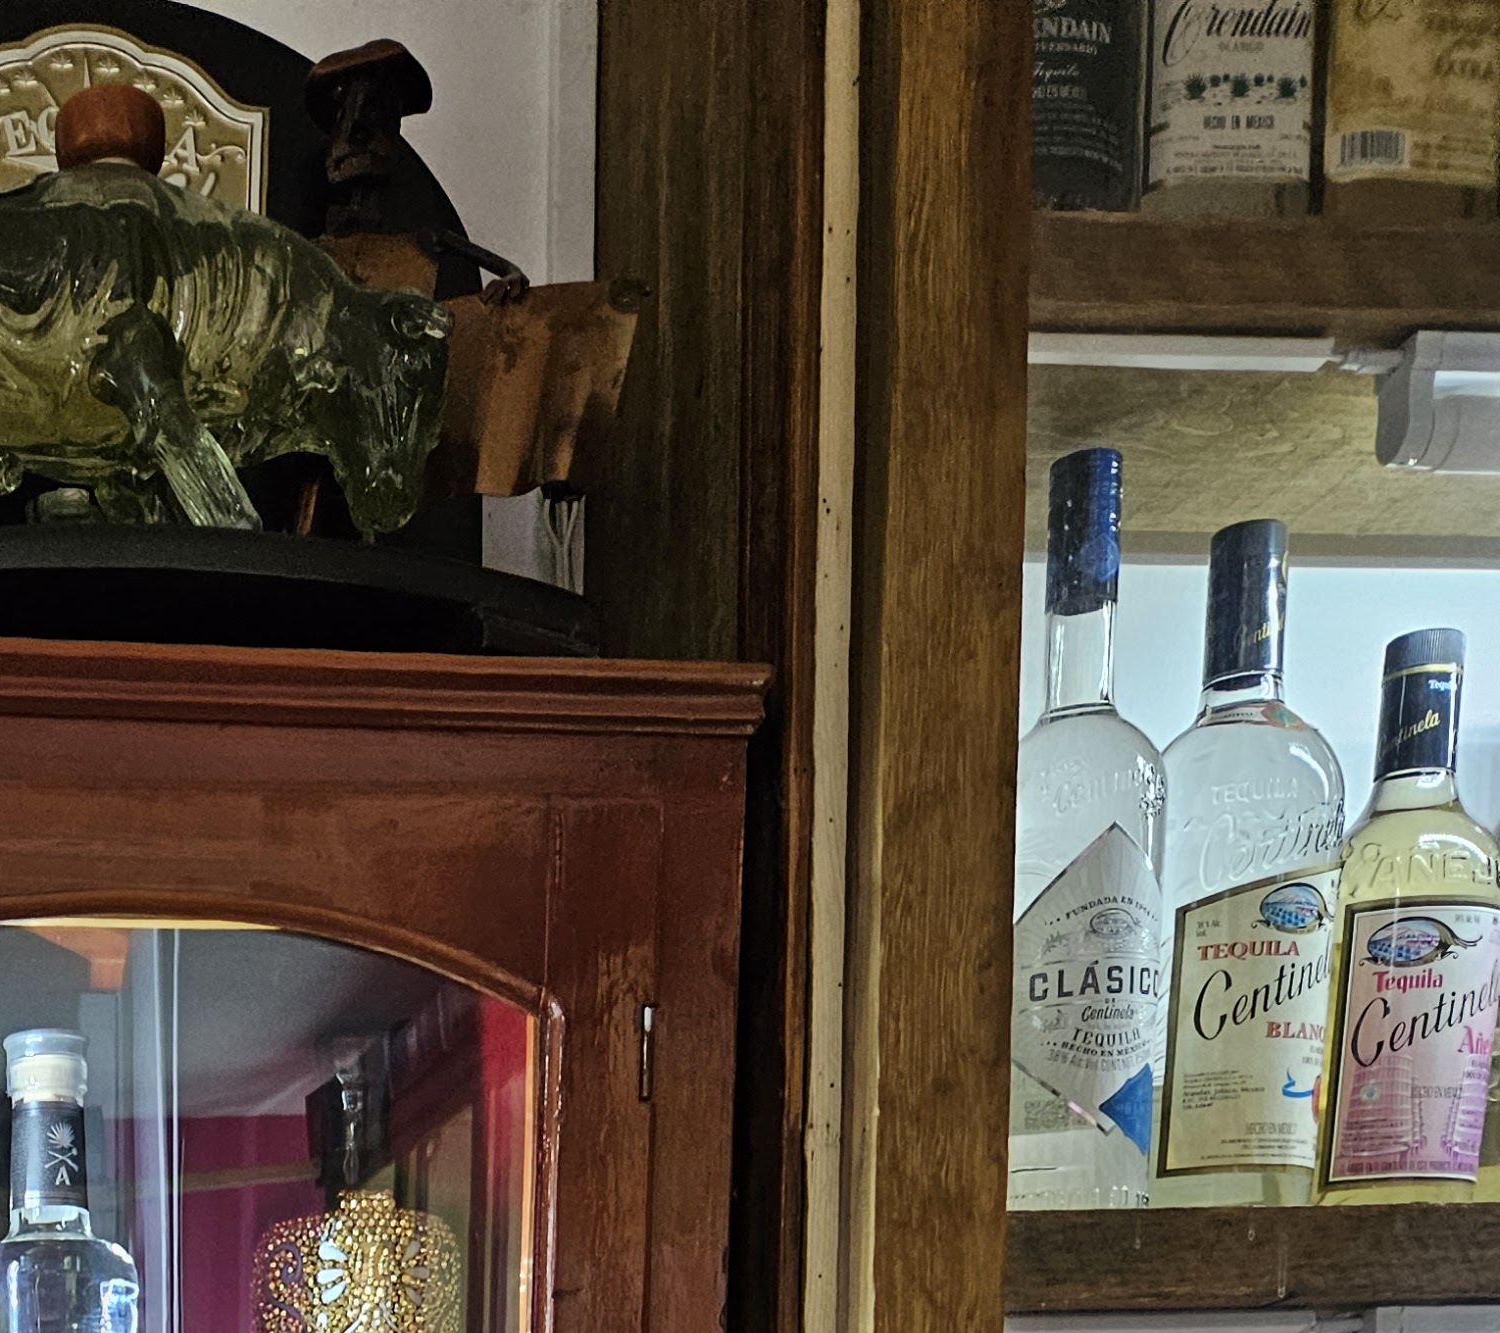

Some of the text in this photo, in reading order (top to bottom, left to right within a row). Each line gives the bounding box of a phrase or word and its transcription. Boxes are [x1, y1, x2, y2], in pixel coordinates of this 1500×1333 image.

[1197, 940, 1300, 961] TEQUILA
[1193, 930, 1331, 1041] Centinel
[1372, 968, 1444, 995] Tequila
[1081, 1002, 1136, 1023] Centinela
[1351, 958, 1500, 1068] Centinel
[1072, 1026, 1141, 1047] TEQUILA
[1061, 1040, 1098, 1056] HECHO
[1100, 1048, 1114, 1057] EN
[54, 1165, 72, 1187] A
